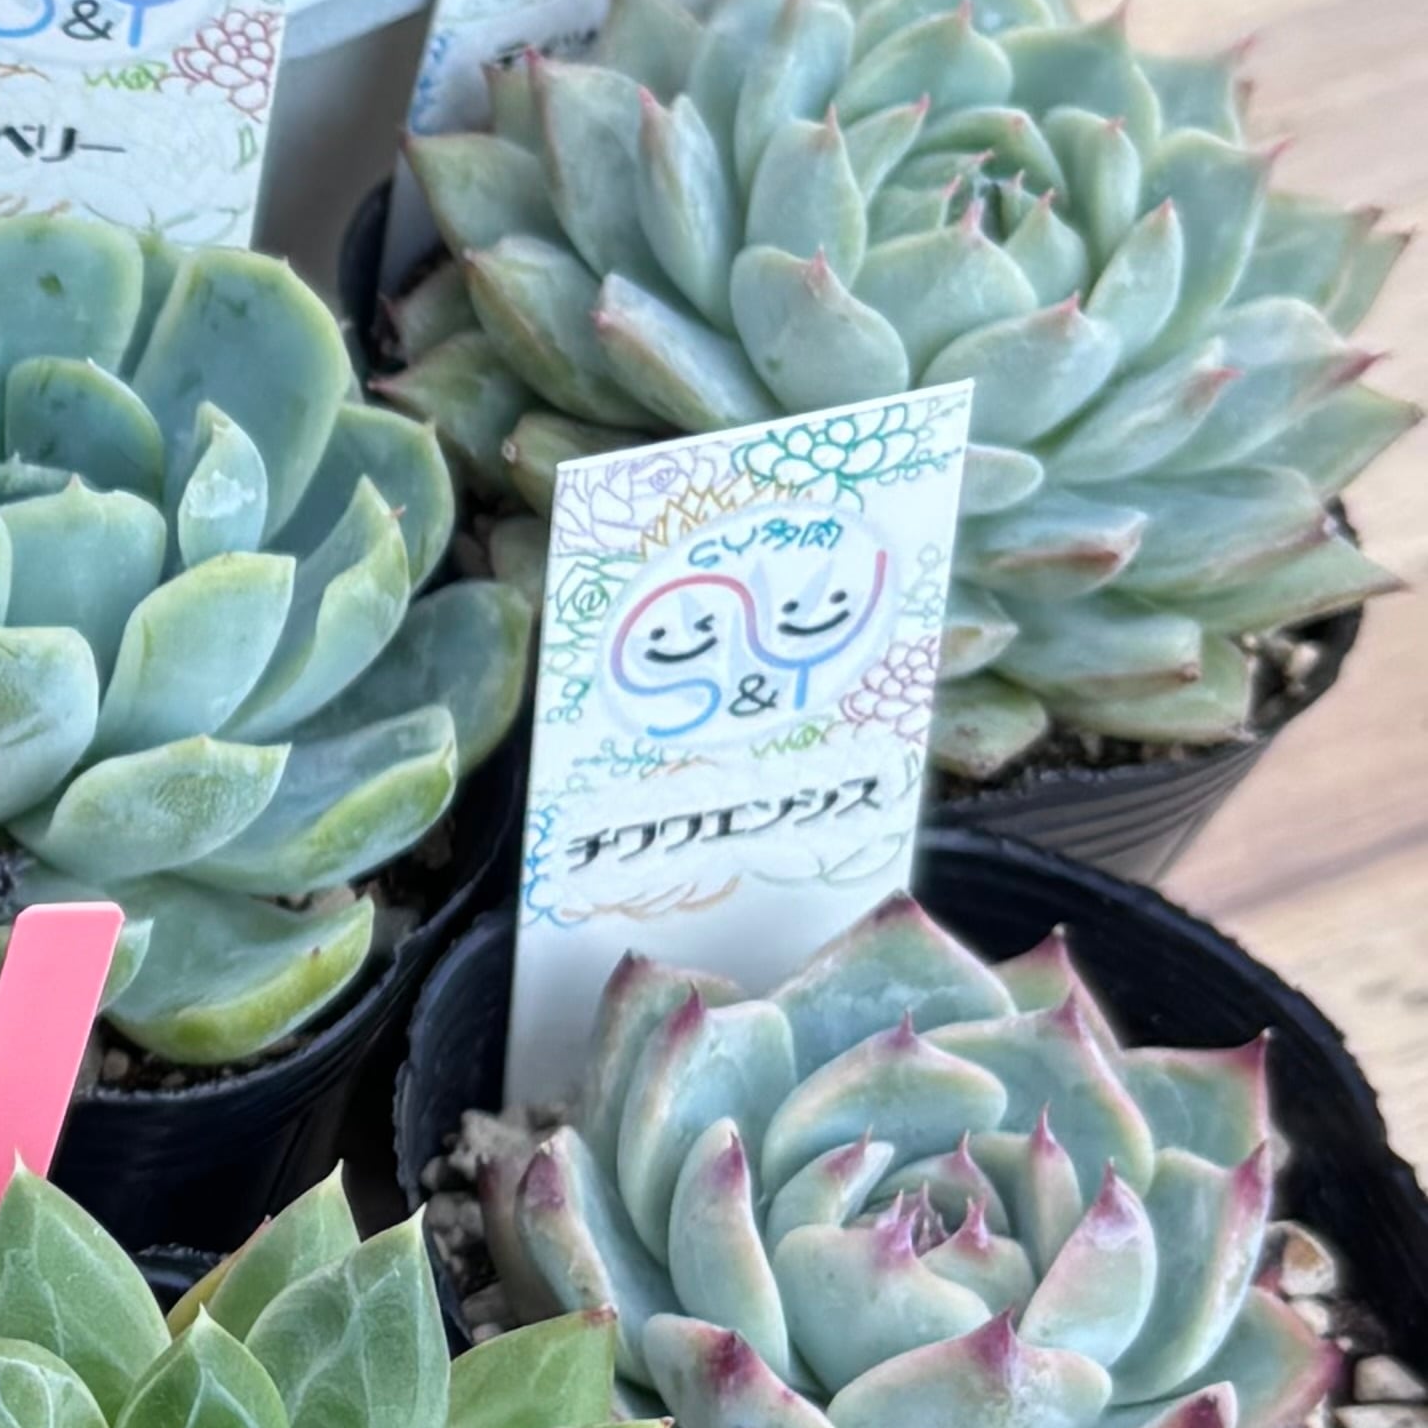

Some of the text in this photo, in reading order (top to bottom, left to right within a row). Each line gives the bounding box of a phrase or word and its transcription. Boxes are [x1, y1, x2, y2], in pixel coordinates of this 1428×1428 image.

[565, 775, 880, 872] チワワエンシス
